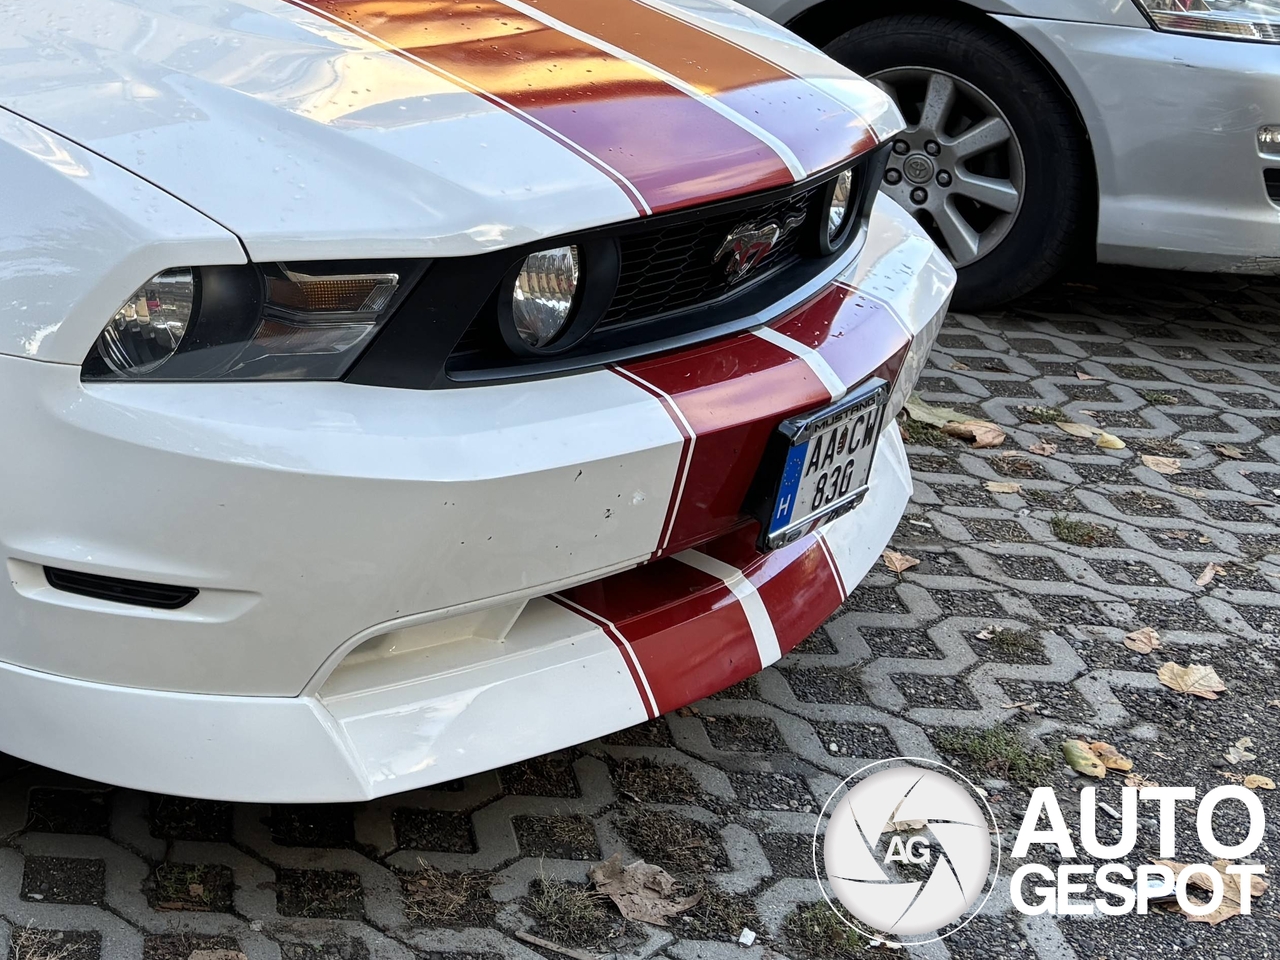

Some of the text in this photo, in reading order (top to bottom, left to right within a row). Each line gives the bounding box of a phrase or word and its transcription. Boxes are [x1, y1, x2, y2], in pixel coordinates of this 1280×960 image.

[814, 396, 876, 433] MUSTANG
[805, 427, 838, 478] AA
[777, 494, 792, 519] H
